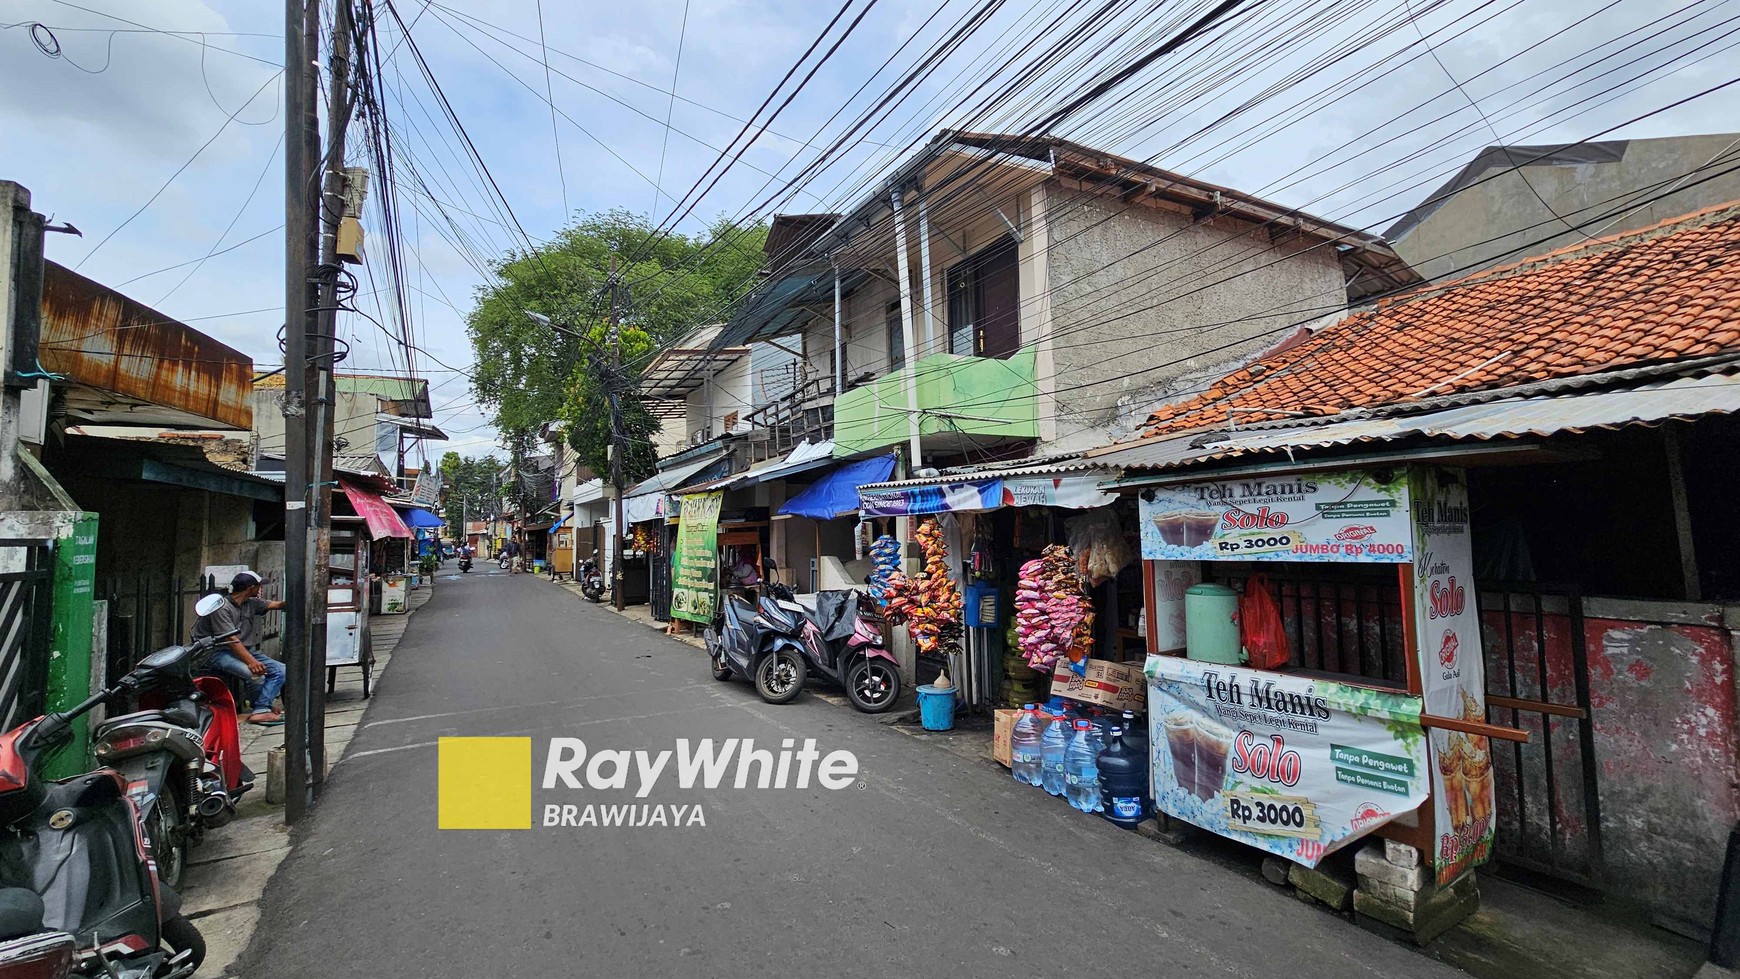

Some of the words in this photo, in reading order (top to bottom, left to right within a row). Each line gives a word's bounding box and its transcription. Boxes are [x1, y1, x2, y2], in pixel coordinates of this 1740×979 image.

[1013, 485, 1045, 495] LEKUKAN
[1194, 483, 1233, 501] Teh
[1240, 478, 1318, 498] Manis
[1276, 495, 1307, 503] Kental
[1346, 501, 1391, 510] Pengawet
[1412, 498, 1435, 524] Teh
[1436, 499, 1468, 524] Manis
[1221, 506, 1289, 530] Solo
[1336, 526, 1376, 541] ORIGINAL
[1291, 543, 1340, 556] JUMBO
[1344, 543, 1363, 557] Rp
[1367, 543, 1405, 555] 4000
[1429, 575, 1466, 620] Solo
[1202, 670, 1243, 706] Teh
[1250, 677, 1332, 722] Manis
[1215, 704, 1240, 720] Wangi
[1240, 708, 1264, 725] Sepet
[1264, 713, 1287, 731] Legit
[1287, 718, 1319, 735] Kental
[1232, 730, 1303, 788] Solo
[1334, 749, 1360, 764] Tanpa
[1361, 755, 1409, 773] Pengawet
[1337, 771, 1356, 783] Tanpa
[1356, 775, 1382, 788] Pemanis
[1382, 781, 1406, 793] Buatan
[1229, 798, 1305, 828] Rp.3000
